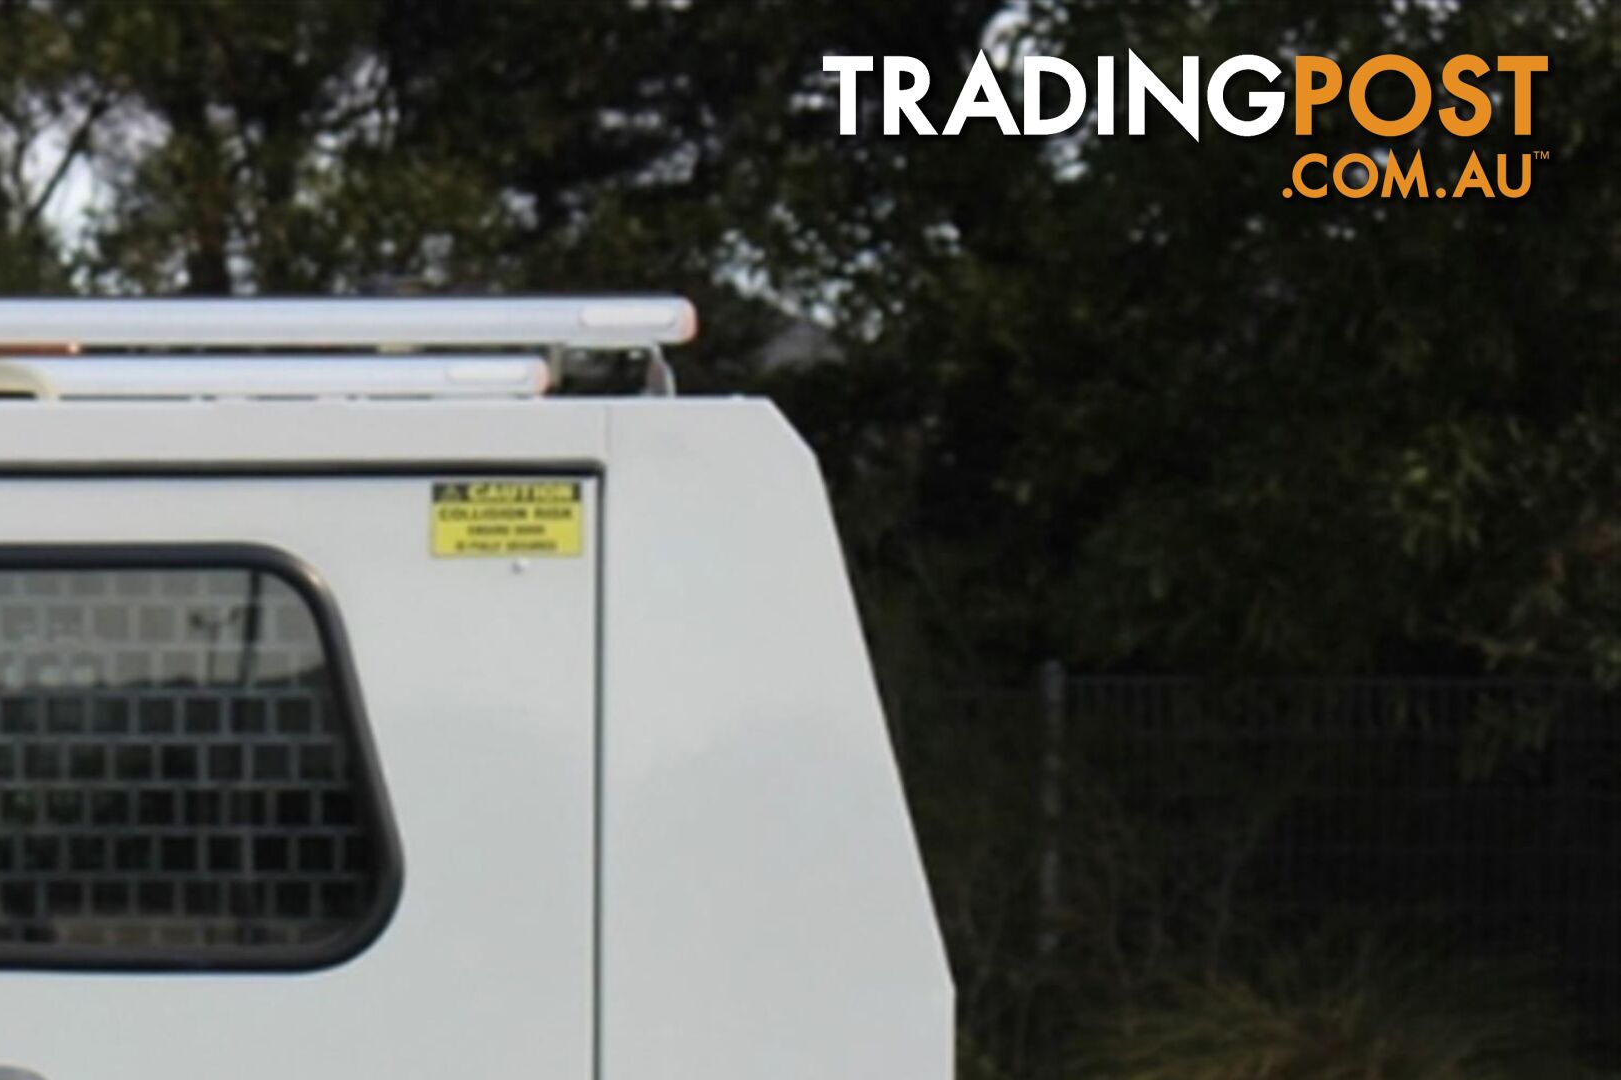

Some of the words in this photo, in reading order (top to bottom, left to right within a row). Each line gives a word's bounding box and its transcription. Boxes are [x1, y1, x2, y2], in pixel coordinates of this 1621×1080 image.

[468, 483, 572, 501] CAUTION
[438, 508, 527, 521] COLLISION
[534, 508, 573, 520] RISK
